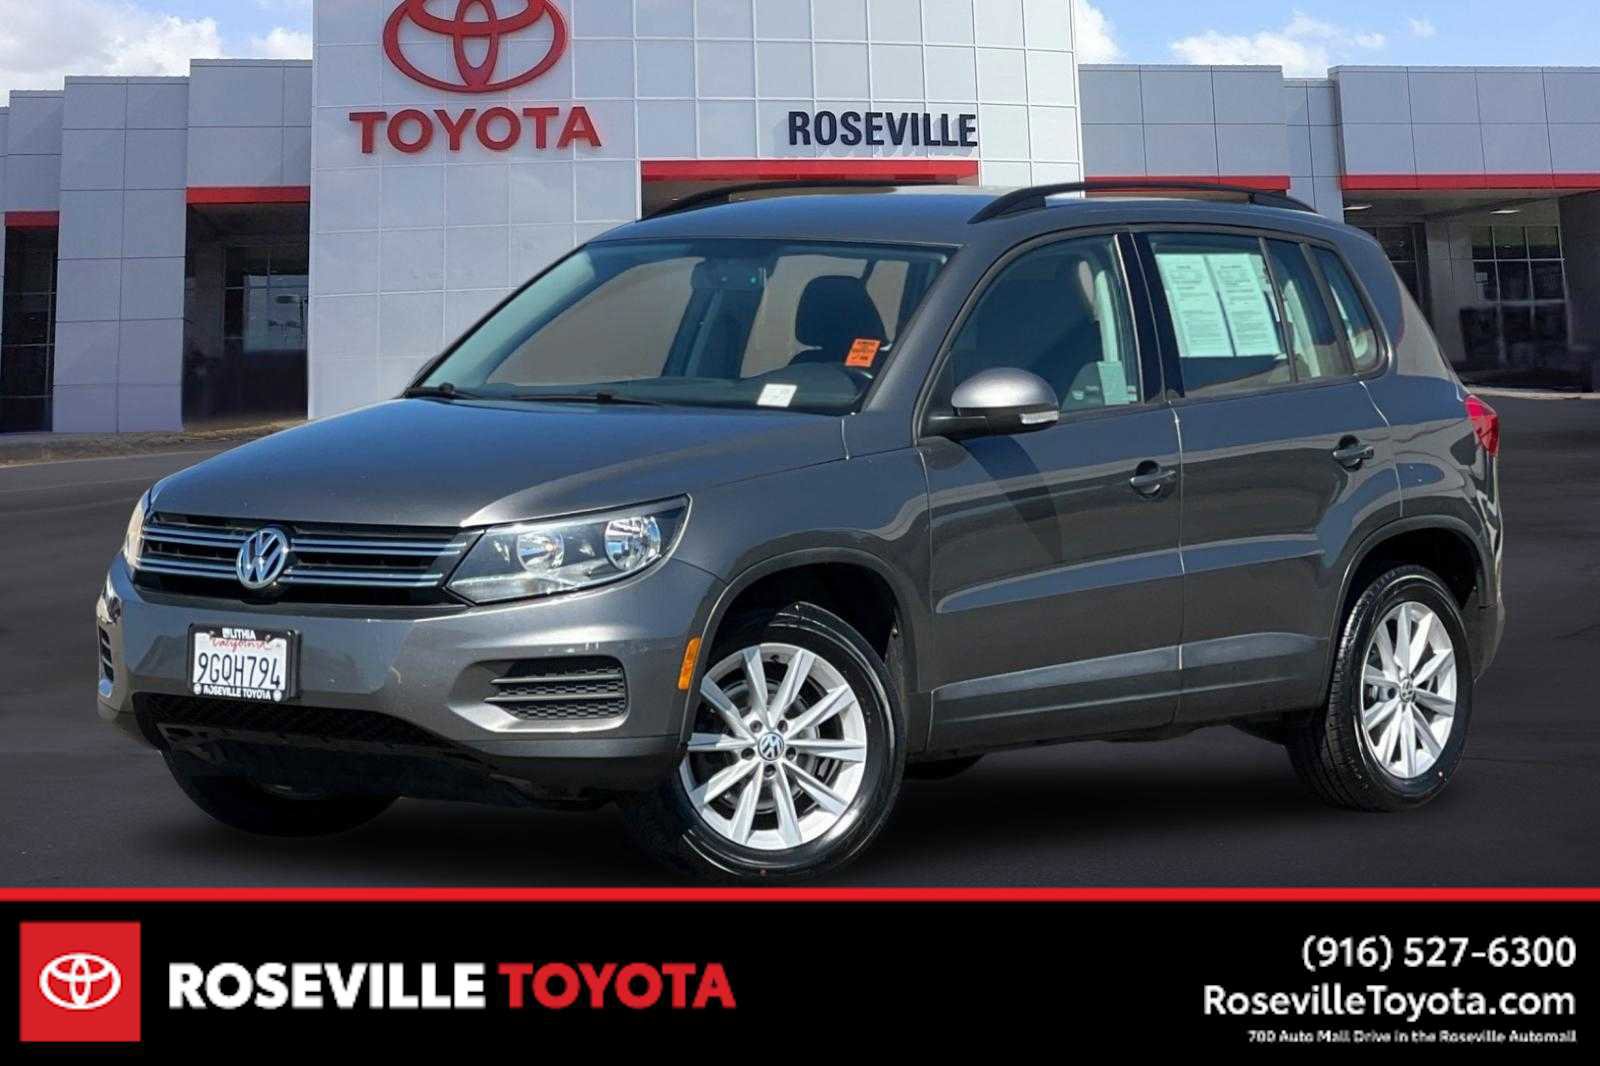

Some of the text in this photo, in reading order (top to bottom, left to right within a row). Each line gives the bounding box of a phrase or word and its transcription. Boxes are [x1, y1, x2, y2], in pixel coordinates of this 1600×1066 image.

[349, 106, 602, 154] TOYOTA
[788, 110, 978, 147] ROSEVILLE
[242, 688, 272, 701] TOYOTA
